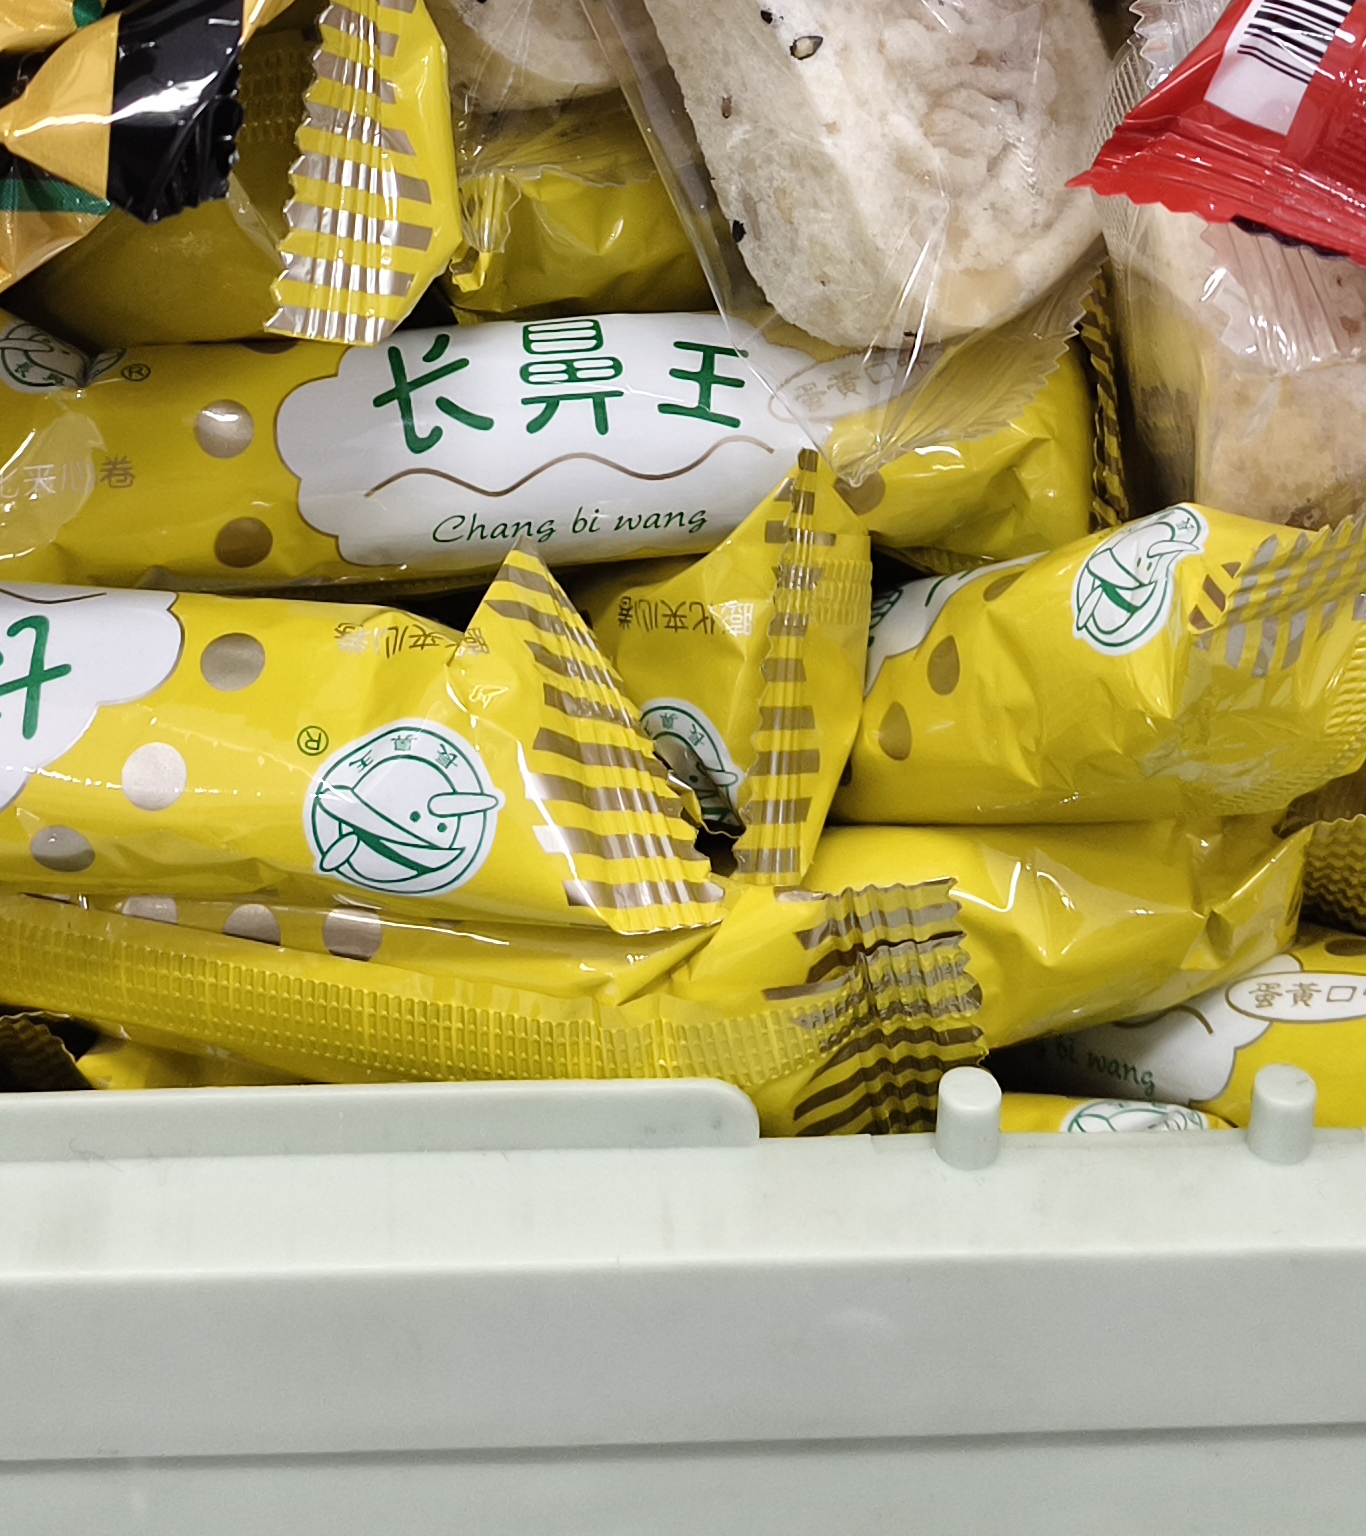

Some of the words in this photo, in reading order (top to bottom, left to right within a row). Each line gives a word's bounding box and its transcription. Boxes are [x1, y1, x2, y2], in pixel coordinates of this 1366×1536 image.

[373, 318, 749, 454] 长鼻王
[432, 511, 555, 544] Chang
[571, 507, 601, 534] bi
[615, 509, 708, 536] wang
